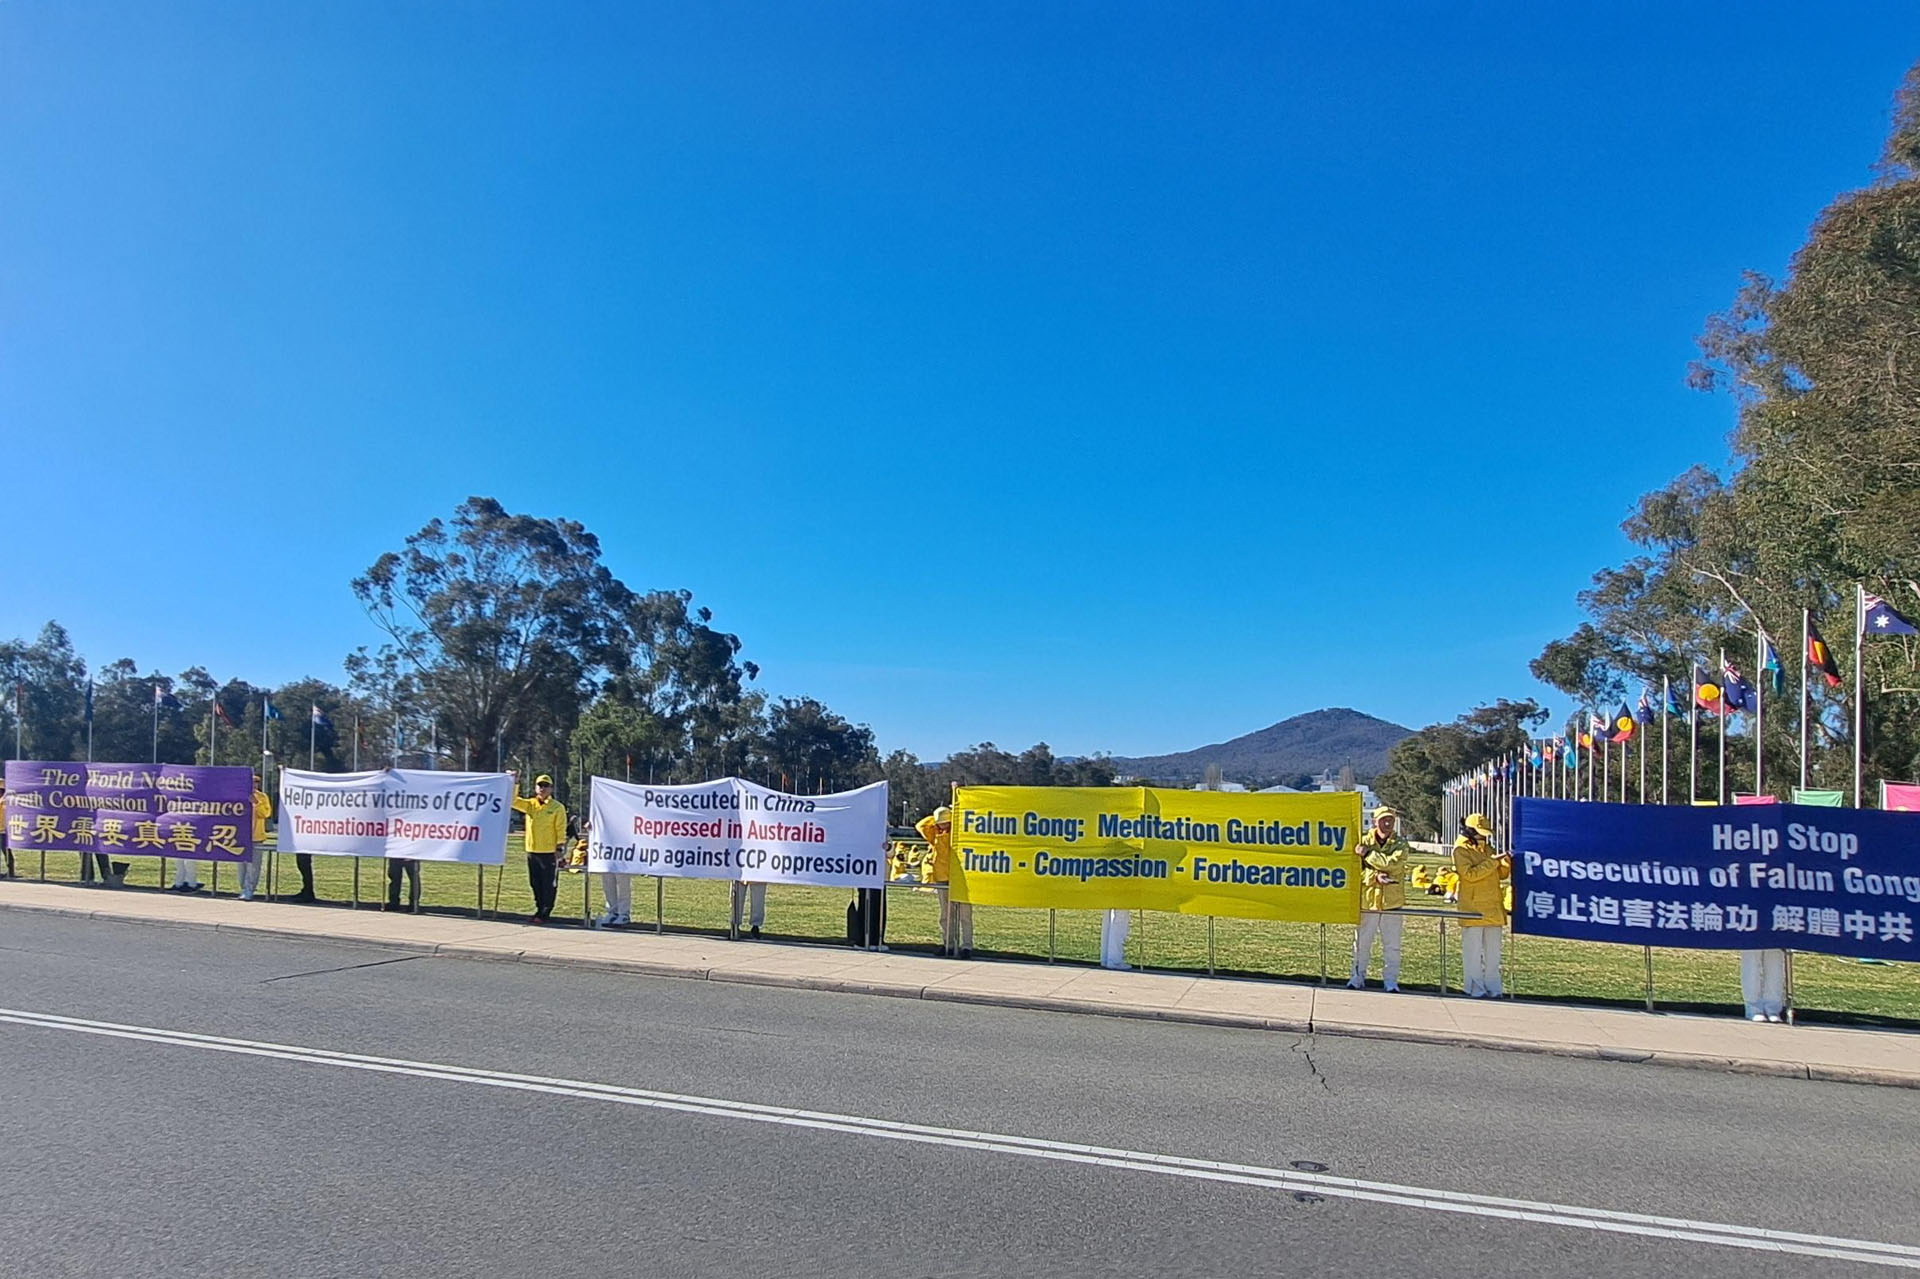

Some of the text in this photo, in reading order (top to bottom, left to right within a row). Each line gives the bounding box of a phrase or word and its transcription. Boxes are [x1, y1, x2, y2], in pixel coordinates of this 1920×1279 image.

[41, 769, 195, 792] The World Needs
[49, 791, 147, 812] Compassion
[154, 794, 245, 816] Tolerance
[284, 787, 502, 814] Help protect victims of CCP's
[644, 790, 815, 814] Persecuted in China
[8, 814, 245, 856] 世界需要真善忍
[294, 815, 480, 842] Transnational Repression
[634, 816, 825, 843] Repressed in Australia
[964, 810, 1346, 851] Falun Gong: Meditation Guided by
[1712, 823, 1859, 859] Help Stop
[592, 841, 878, 876] Stand up against CCP oppression
[962, 848, 1011, 874] Truth
[1034, 852, 1167, 882] Compassion
[1193, 857, 1346, 888] Forbearance
[1524, 851, 1920, 902] Persecution of Falun Gong
[1525, 891, 1914, 943] 停止迫害法輪功 解體中共
